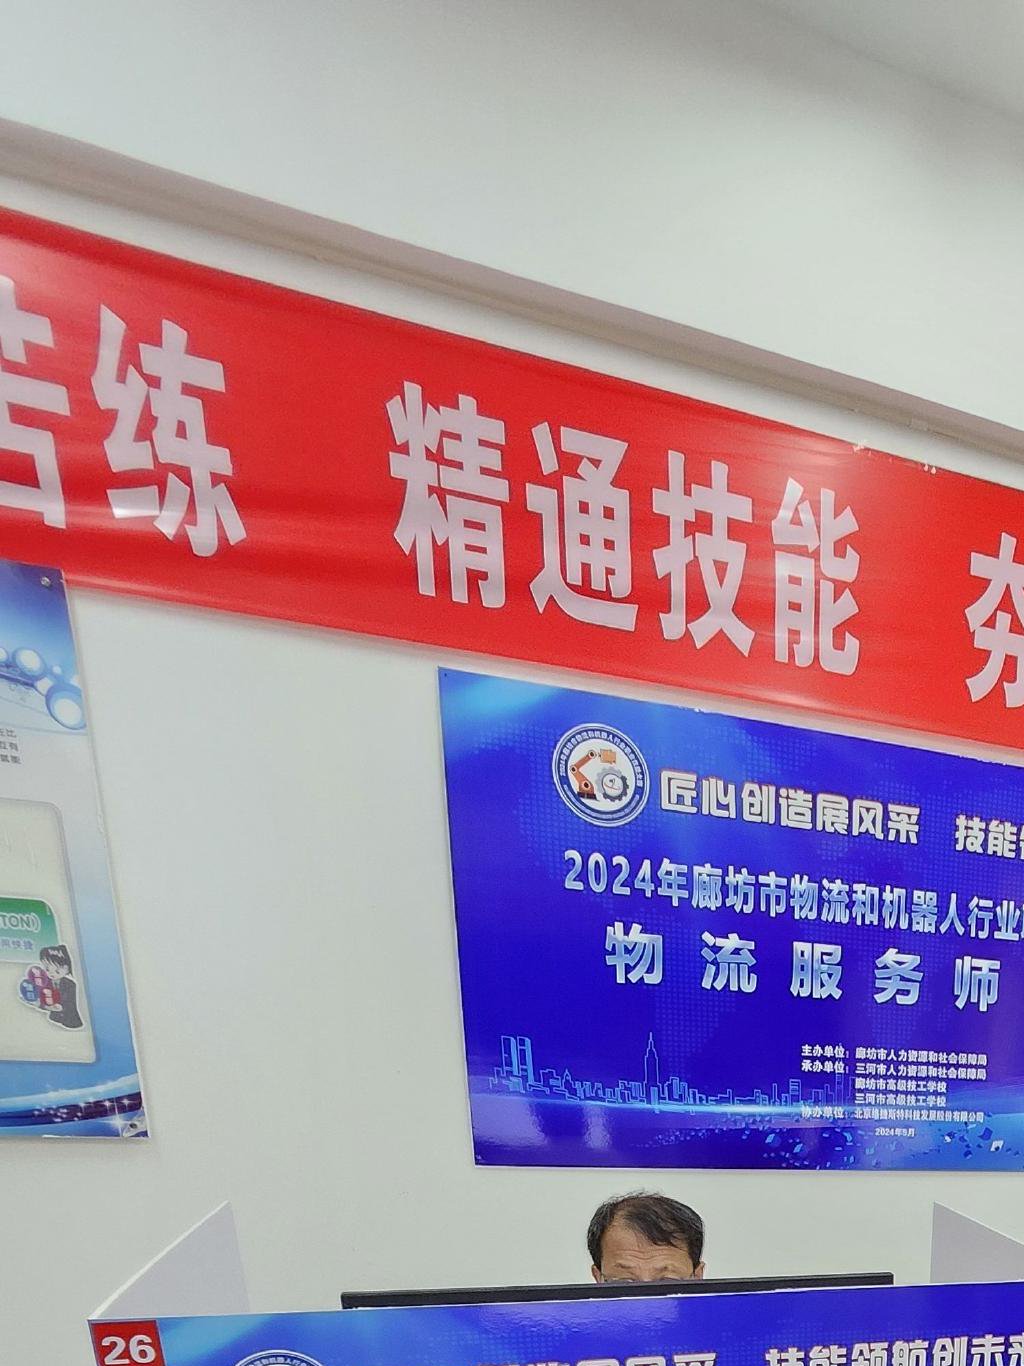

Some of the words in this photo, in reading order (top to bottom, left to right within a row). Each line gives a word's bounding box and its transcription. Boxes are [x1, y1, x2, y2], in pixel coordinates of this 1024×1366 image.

[386, 380, 862, 677] 精通技能
[659, 770, 922, 846] 匠心创造展风采
[854, 1078, 947, 1093] 廊坊市高级技工学校
[854, 1093, 947, 1107] 三河市高级技工学校
[875, 1127, 916, 1138] 2024年9月
[100, 1333, 155, 1366] 26
